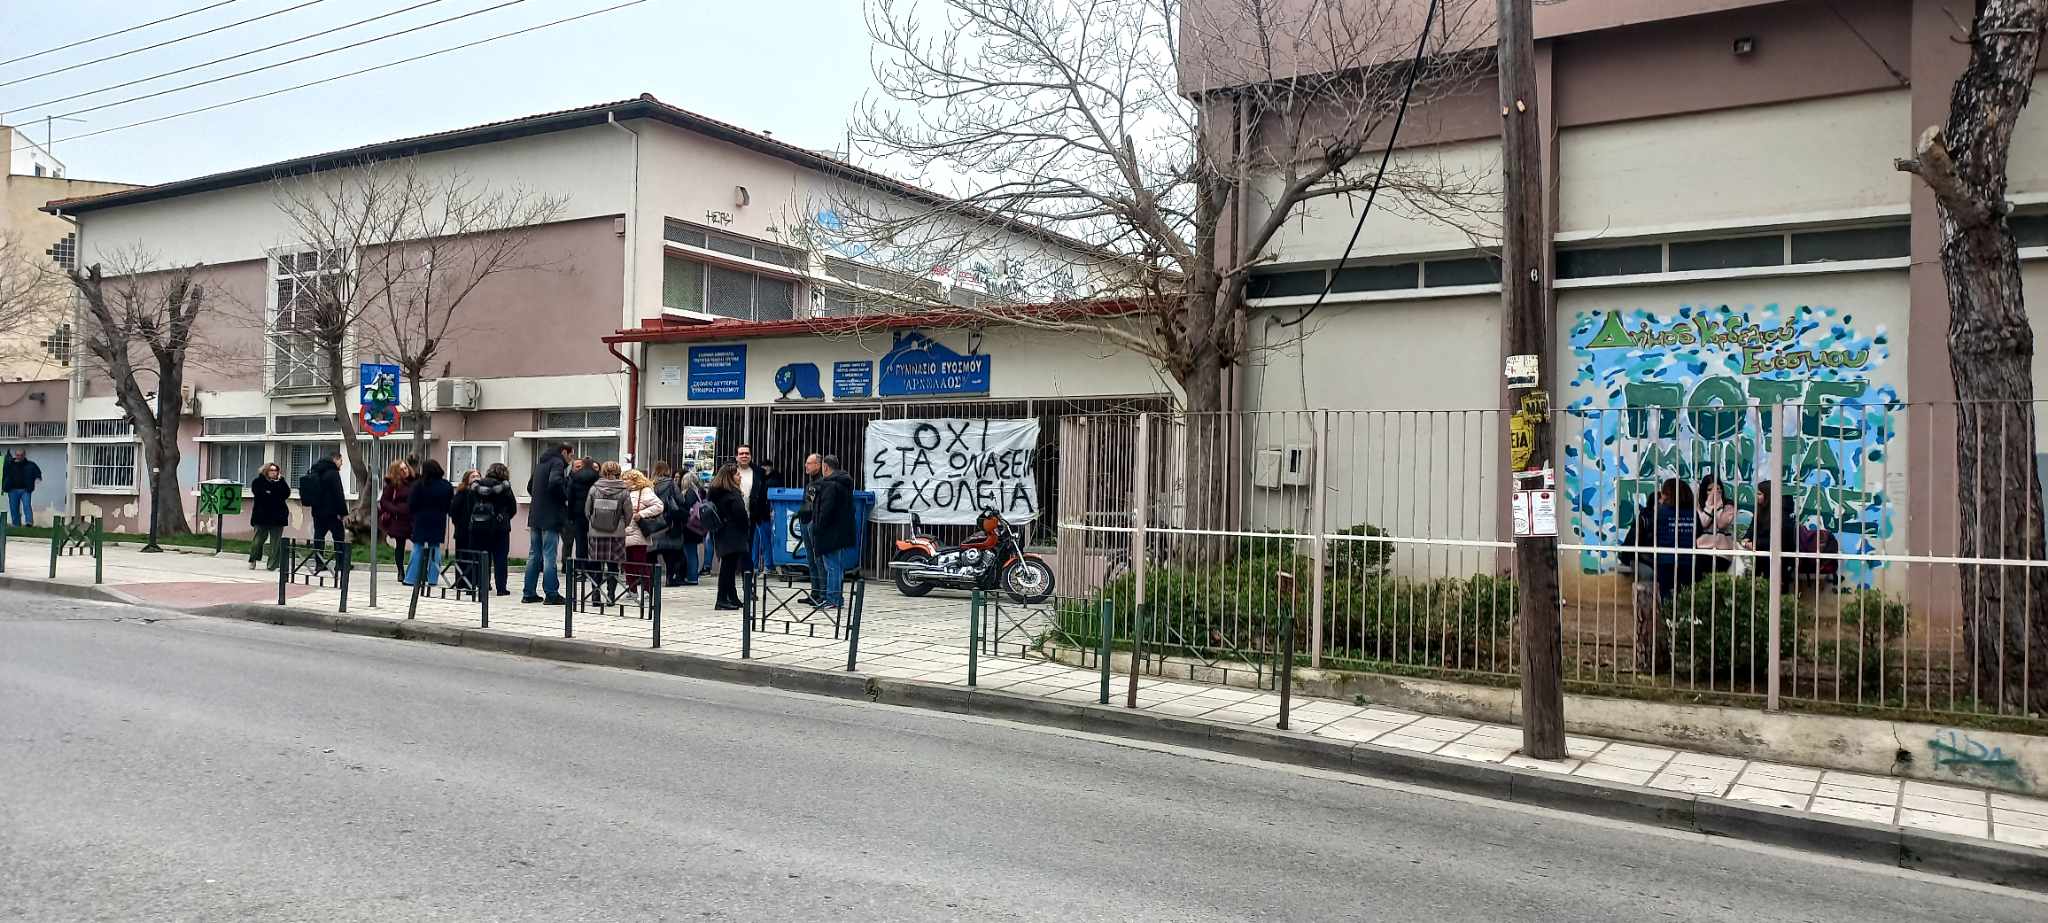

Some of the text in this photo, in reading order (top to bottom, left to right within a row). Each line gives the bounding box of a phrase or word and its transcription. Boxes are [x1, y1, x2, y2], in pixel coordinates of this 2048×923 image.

[896, 363, 937, 376] ΓΥΜΝΑΣΙΟ
[941, 360, 982, 374] ΕΥΟΣΜΟΥ
[914, 420, 988, 453] ΟΧΙ
[873, 446, 935, 479] ΣΤΑ
